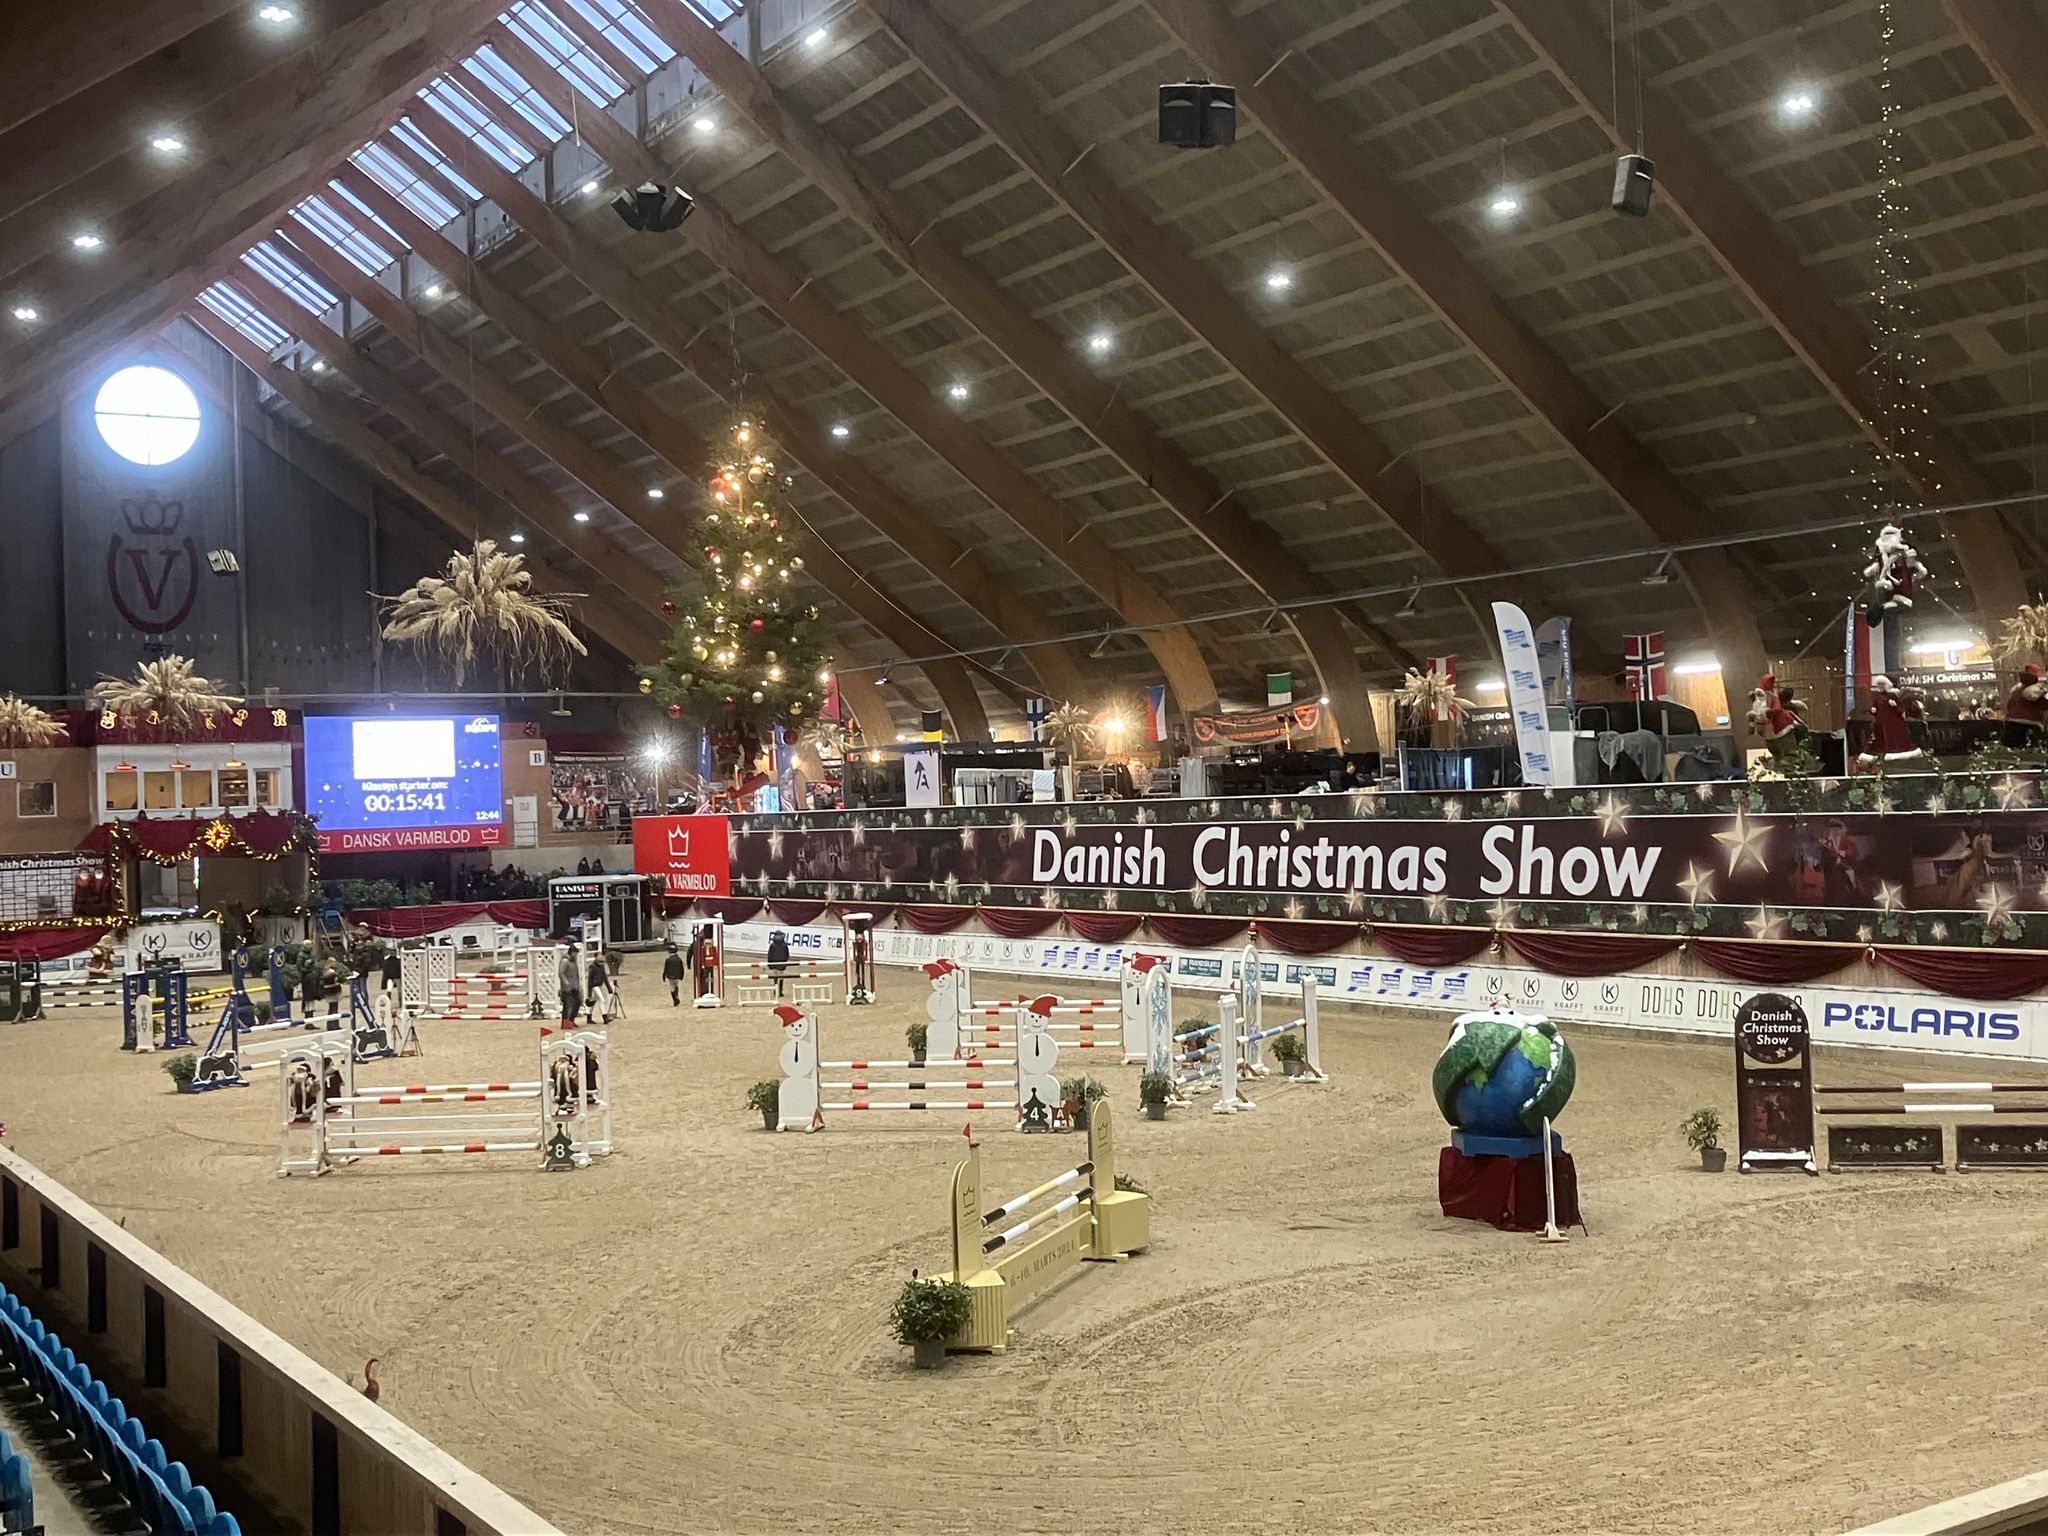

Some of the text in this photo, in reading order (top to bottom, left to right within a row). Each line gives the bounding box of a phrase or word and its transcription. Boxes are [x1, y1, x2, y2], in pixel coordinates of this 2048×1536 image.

[1936, 673, 1980, 683] Christmas
[533, 752, 542, 763] B
[365, 792, 446, 812] 00:15:41
[475, 810, 500, 820] 12:44
[343, 829, 471, 849] DANSK VARMBLOD
[20, 859, 75, 869] Christmas
[75, 856, 105, 866] Show
[1033, 824, 1662, 898] Danish Christmas Show
[672, 873, 716, 890] VARMBLOD
[768, 932, 821, 948] PLARIS
[856, 989, 863, 998] 9
[1642, 986, 1684, 1015] DDHS
[170, 978, 178, 1037] KRAFFT
[1697, 989, 1742, 1019] DDHS
[1751, 1010, 1792, 1021] Danish
[1824, 1002, 2020, 1040] POLARIS
[1742, 1022, 1803, 1033] Christmas
[1756, 1034, 1790, 1045] Show
[1030, 1106, 1040, 1121] 4
[1056, 1108, 1065, 1119] A
[555, 1143, 565, 1159] 8
